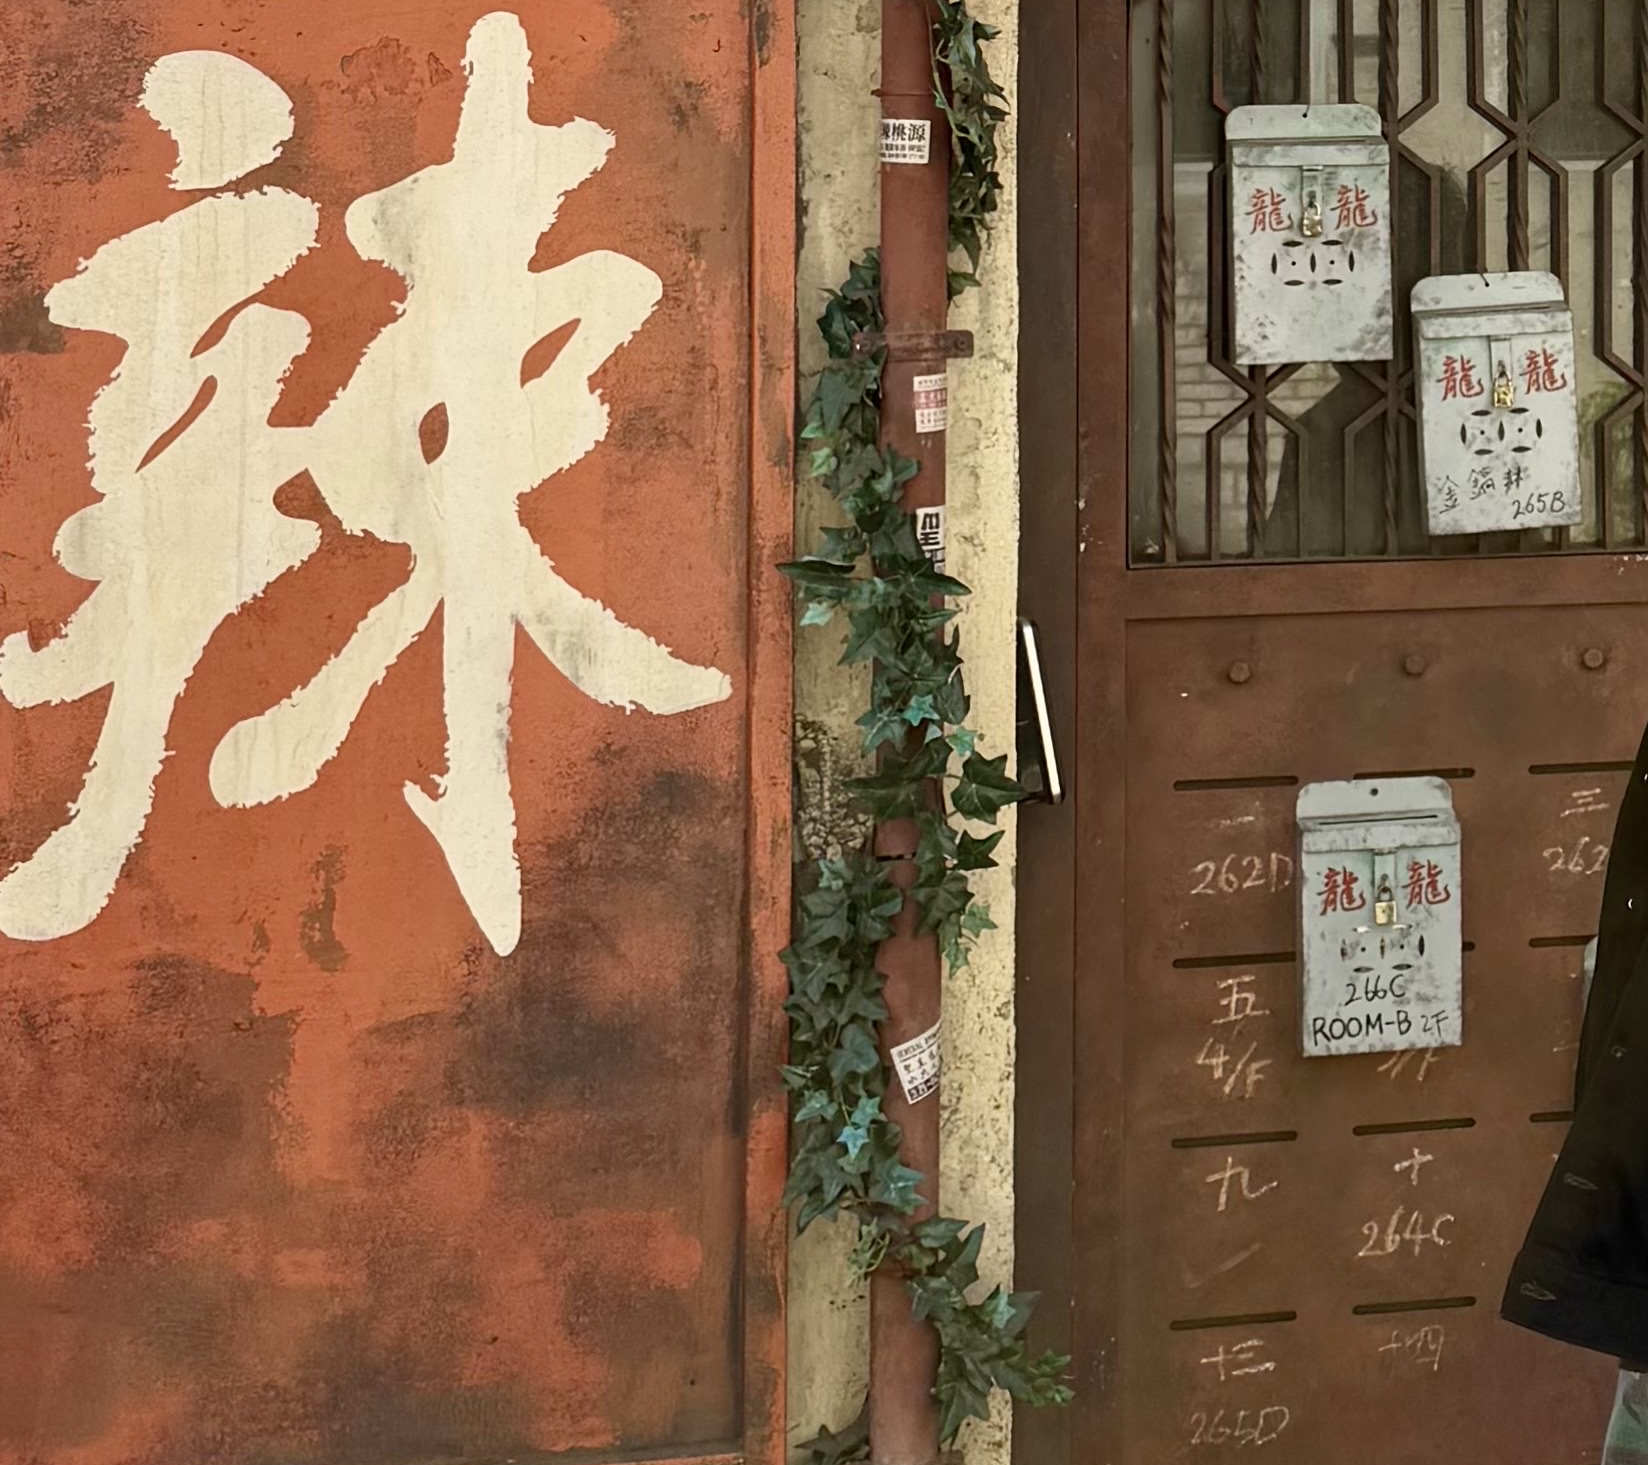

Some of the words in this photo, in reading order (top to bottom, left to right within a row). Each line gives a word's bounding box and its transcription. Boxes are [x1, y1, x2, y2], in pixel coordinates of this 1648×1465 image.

[1245, 187, 1294, 235] 龍
[1330, 184, 1378, 230] 龍
[1436, 354, 1484, 401] 龍
[1520, 347, 1567, 395] 龍
[1512, 490, 1566, 519] 265B
[1560, 788, 1610, 817] 三
[1190, 852, 1295, 894] 262D
[1317, 866, 1367, 916] 龍
[1402, 859, 1451, 909] 龍
[1212, 975, 1270, 1024] 五
[1344, 974, 1406, 1006] 266C
[1312, 1010, 1413, 1046] ROOM-B
[1421, 1010, 1449, 1037] 2F
[1205, 1156, 1278, 1212] 九
[1356, 1205, 1455, 1256] 264C
